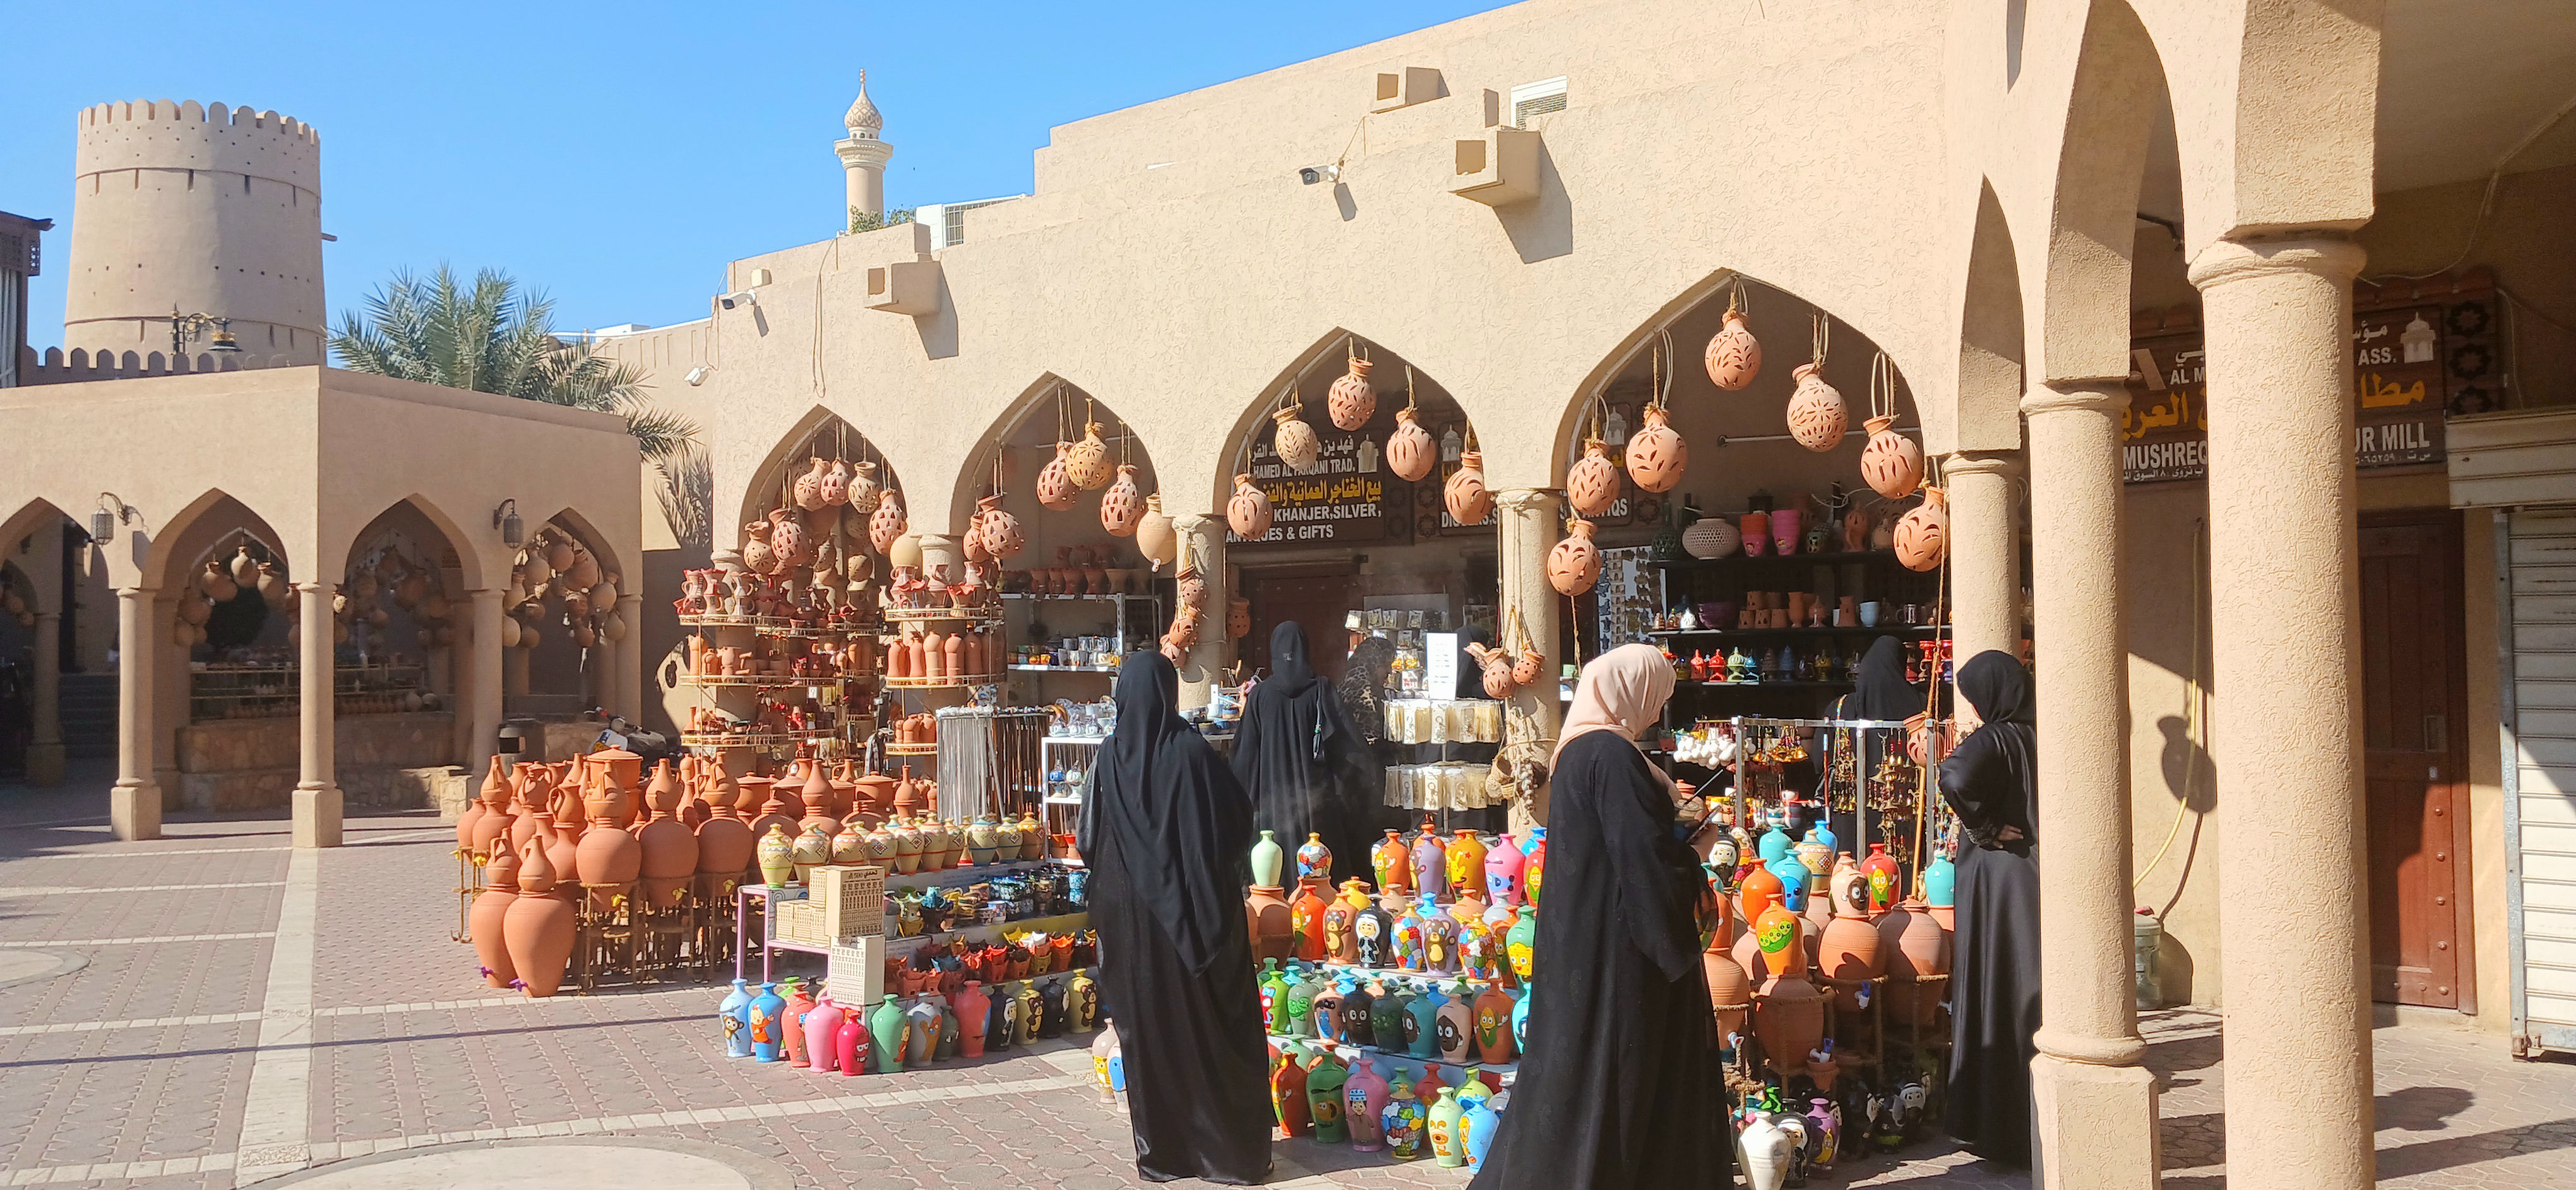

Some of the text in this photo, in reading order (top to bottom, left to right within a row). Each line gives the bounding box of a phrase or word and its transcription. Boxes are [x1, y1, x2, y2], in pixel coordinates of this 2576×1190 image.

[2169, 369, 2190, 385] AL
[2358, 347, 2397, 366] ASS.
[1323, 438, 1336, 456] بن
[1337, 435, 1354, 455] فهد
[2382, 422, 2430, 451] MILL
[1330, 459, 1356, 474] TRAD.
[1287, 479, 1327, 507] العمانية
[1327, 477, 1364, 505] الخناجر
[1366, 480, 1381, 503] بيع
[1287, 527, 1295, 540] &
[1299, 524, 1333, 539] GIFTS
